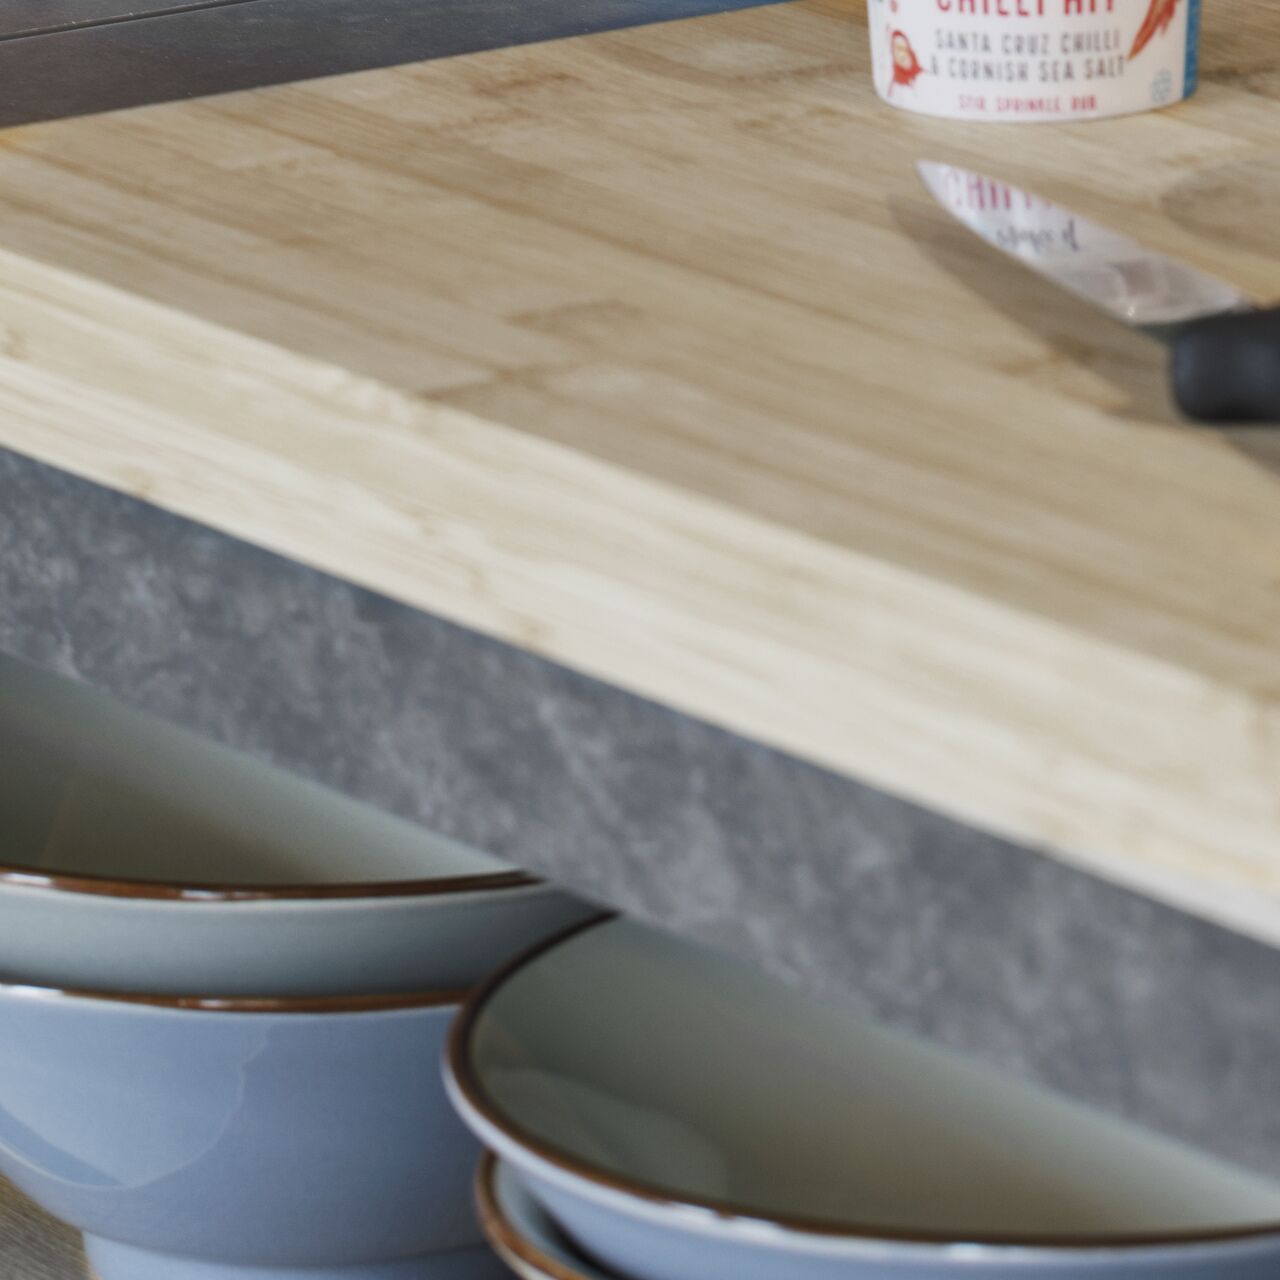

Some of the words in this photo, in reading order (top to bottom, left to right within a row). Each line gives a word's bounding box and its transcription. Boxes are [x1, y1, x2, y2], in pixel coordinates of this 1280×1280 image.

[935, 28, 992, 53] SANTA
[1001, 32, 1051, 56] CRUZ
[948, 57, 1029, 82] CORNISH
[1039, 59, 1075, 82] SEA
[1084, 54, 1125, 79] SALT
